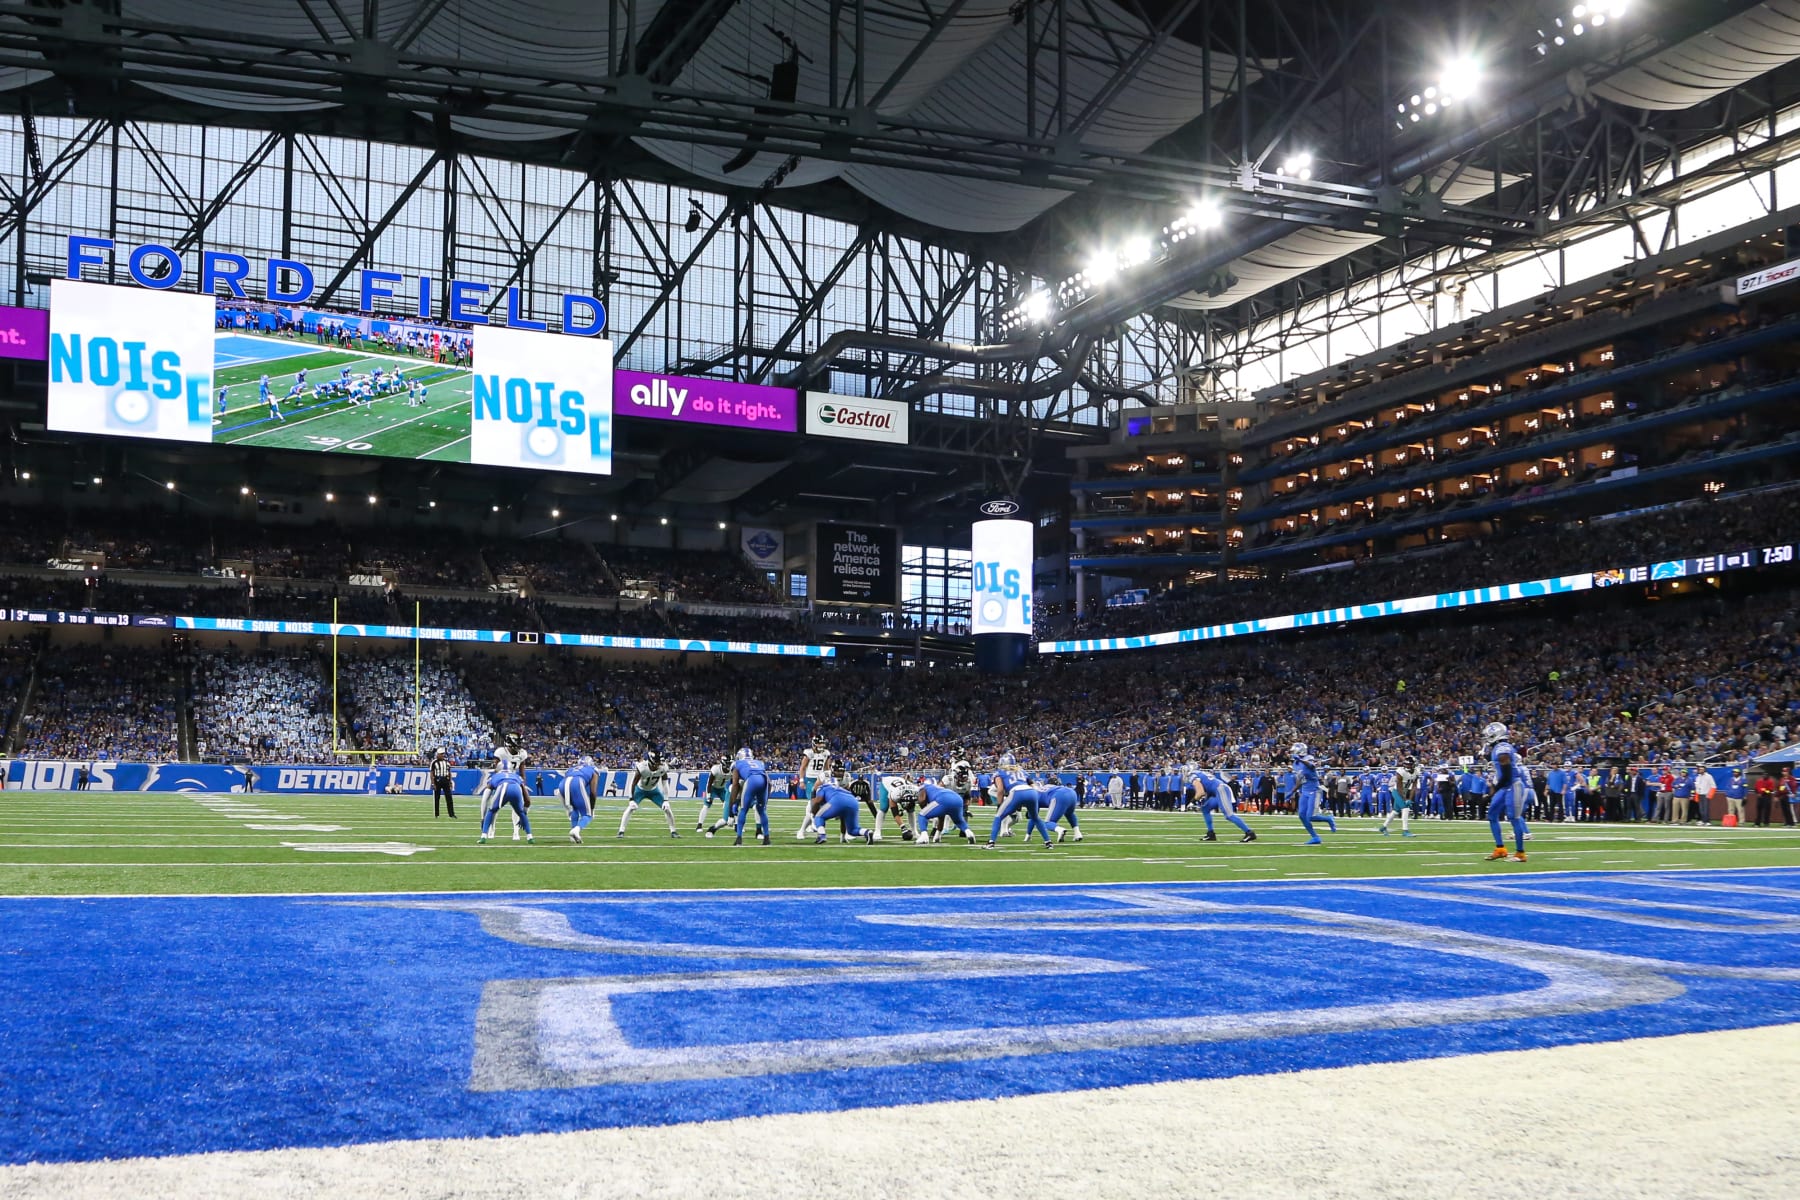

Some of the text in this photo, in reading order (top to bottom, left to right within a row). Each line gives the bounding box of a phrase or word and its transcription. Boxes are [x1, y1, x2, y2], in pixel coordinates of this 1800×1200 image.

[67, 235, 607, 337] FORD FIELD
[630, 378, 782, 421] ally do it right.
[836, 407, 891, 429] Castrol
[987, 502, 1011, 513] Ford
[846, 530, 868, 543] The
[833, 542, 880, 554] network
[1762, 545, 1792, 564] 7:50
[833, 552, 880, 565] America
[1742, 552, 1750, 568] 1
[833, 564, 880, 577] relies on
[58, 612, 65, 623] 3
[118, 614, 129, 626] 13
[216, 618, 313, 633] MAKE SOME NOISE
[386, 626, 478, 640] MAKE SOME NOISE
[580, 635, 665, 649] MAKE SOME NOISE
[728, 642, 808, 656] MAKE SOME NOISE
[812, 759, 824, 771] 16
[390, 771, 458, 790] LIOS
